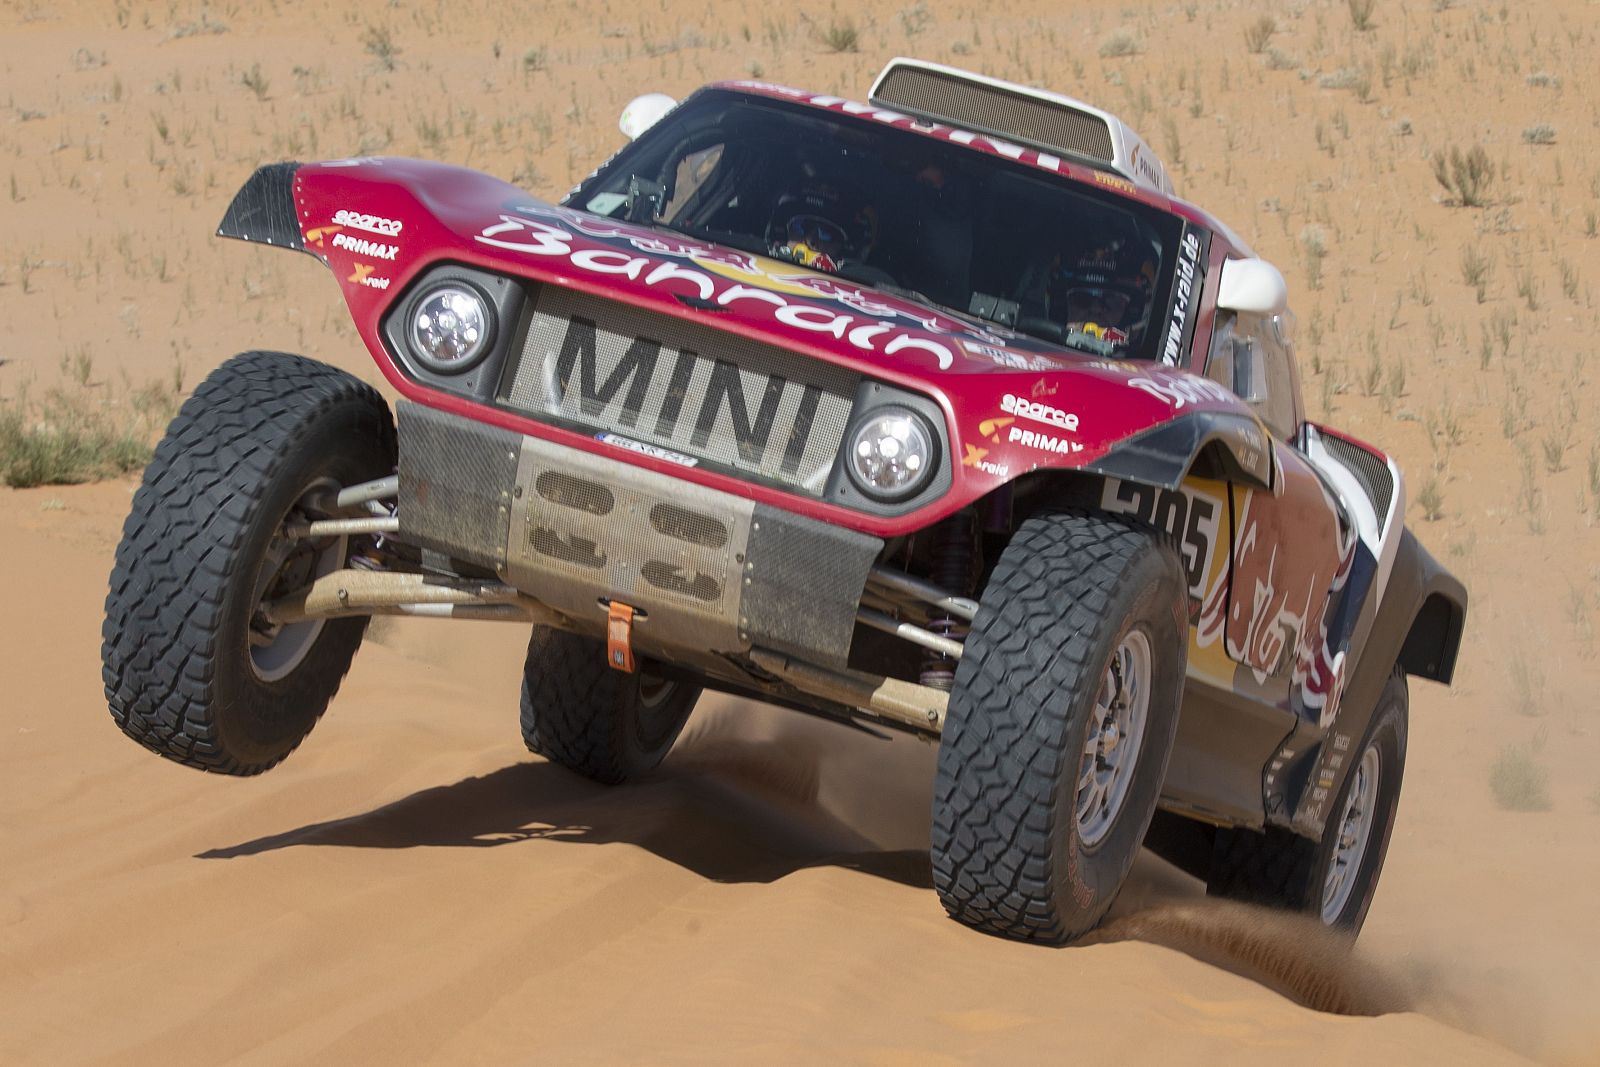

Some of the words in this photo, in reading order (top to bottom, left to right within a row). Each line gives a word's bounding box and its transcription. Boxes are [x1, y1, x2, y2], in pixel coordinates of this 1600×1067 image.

[331, 210, 403, 236] sparco
[332, 233, 399, 260] PRIMAX
[475, 214, 953, 370] Bahrain
[555, 315, 824, 478] MINI
[1000, 394, 1079, 431] sparco
